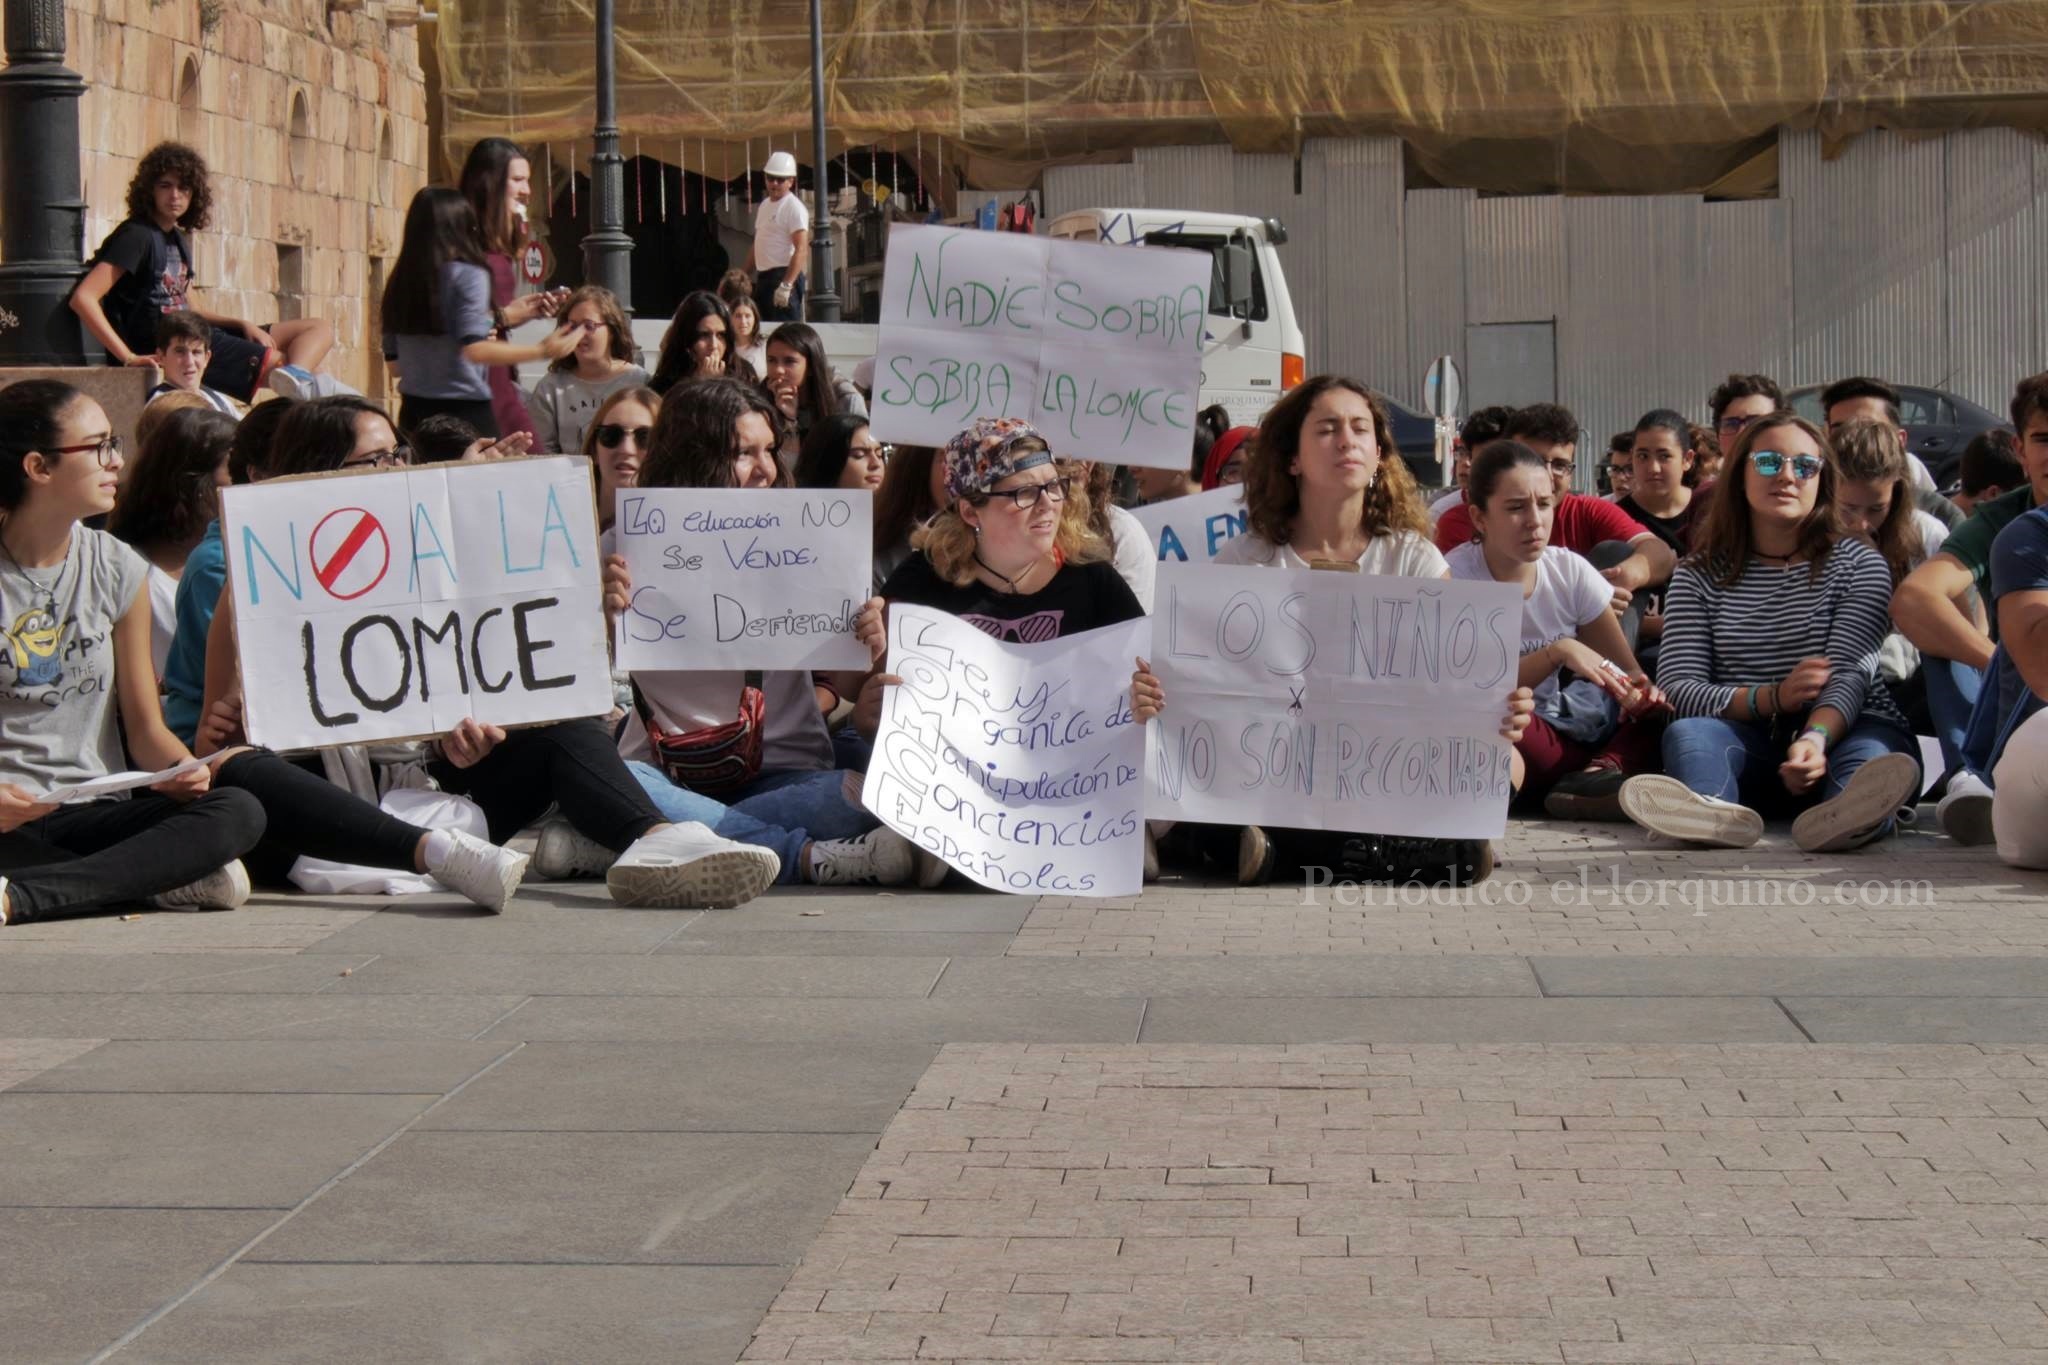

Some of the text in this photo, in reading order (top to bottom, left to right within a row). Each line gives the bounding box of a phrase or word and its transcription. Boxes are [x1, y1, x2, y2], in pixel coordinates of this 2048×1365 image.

[1053, 280, 1205, 355] SOBRA
[881, 355, 1011, 422] SOBRA
[408, 503, 458, 593] A
[497, 484, 582, 575] LA
[802, 500, 851, 527] NO
[663, 545, 704, 570] Se
[301, 597, 577, 728] LOMCE
[1169, 584, 1509, 690] LOS NIÑOS
[1156, 719, 1217, 801] NO
[1240, 720, 1316, 797] SON
